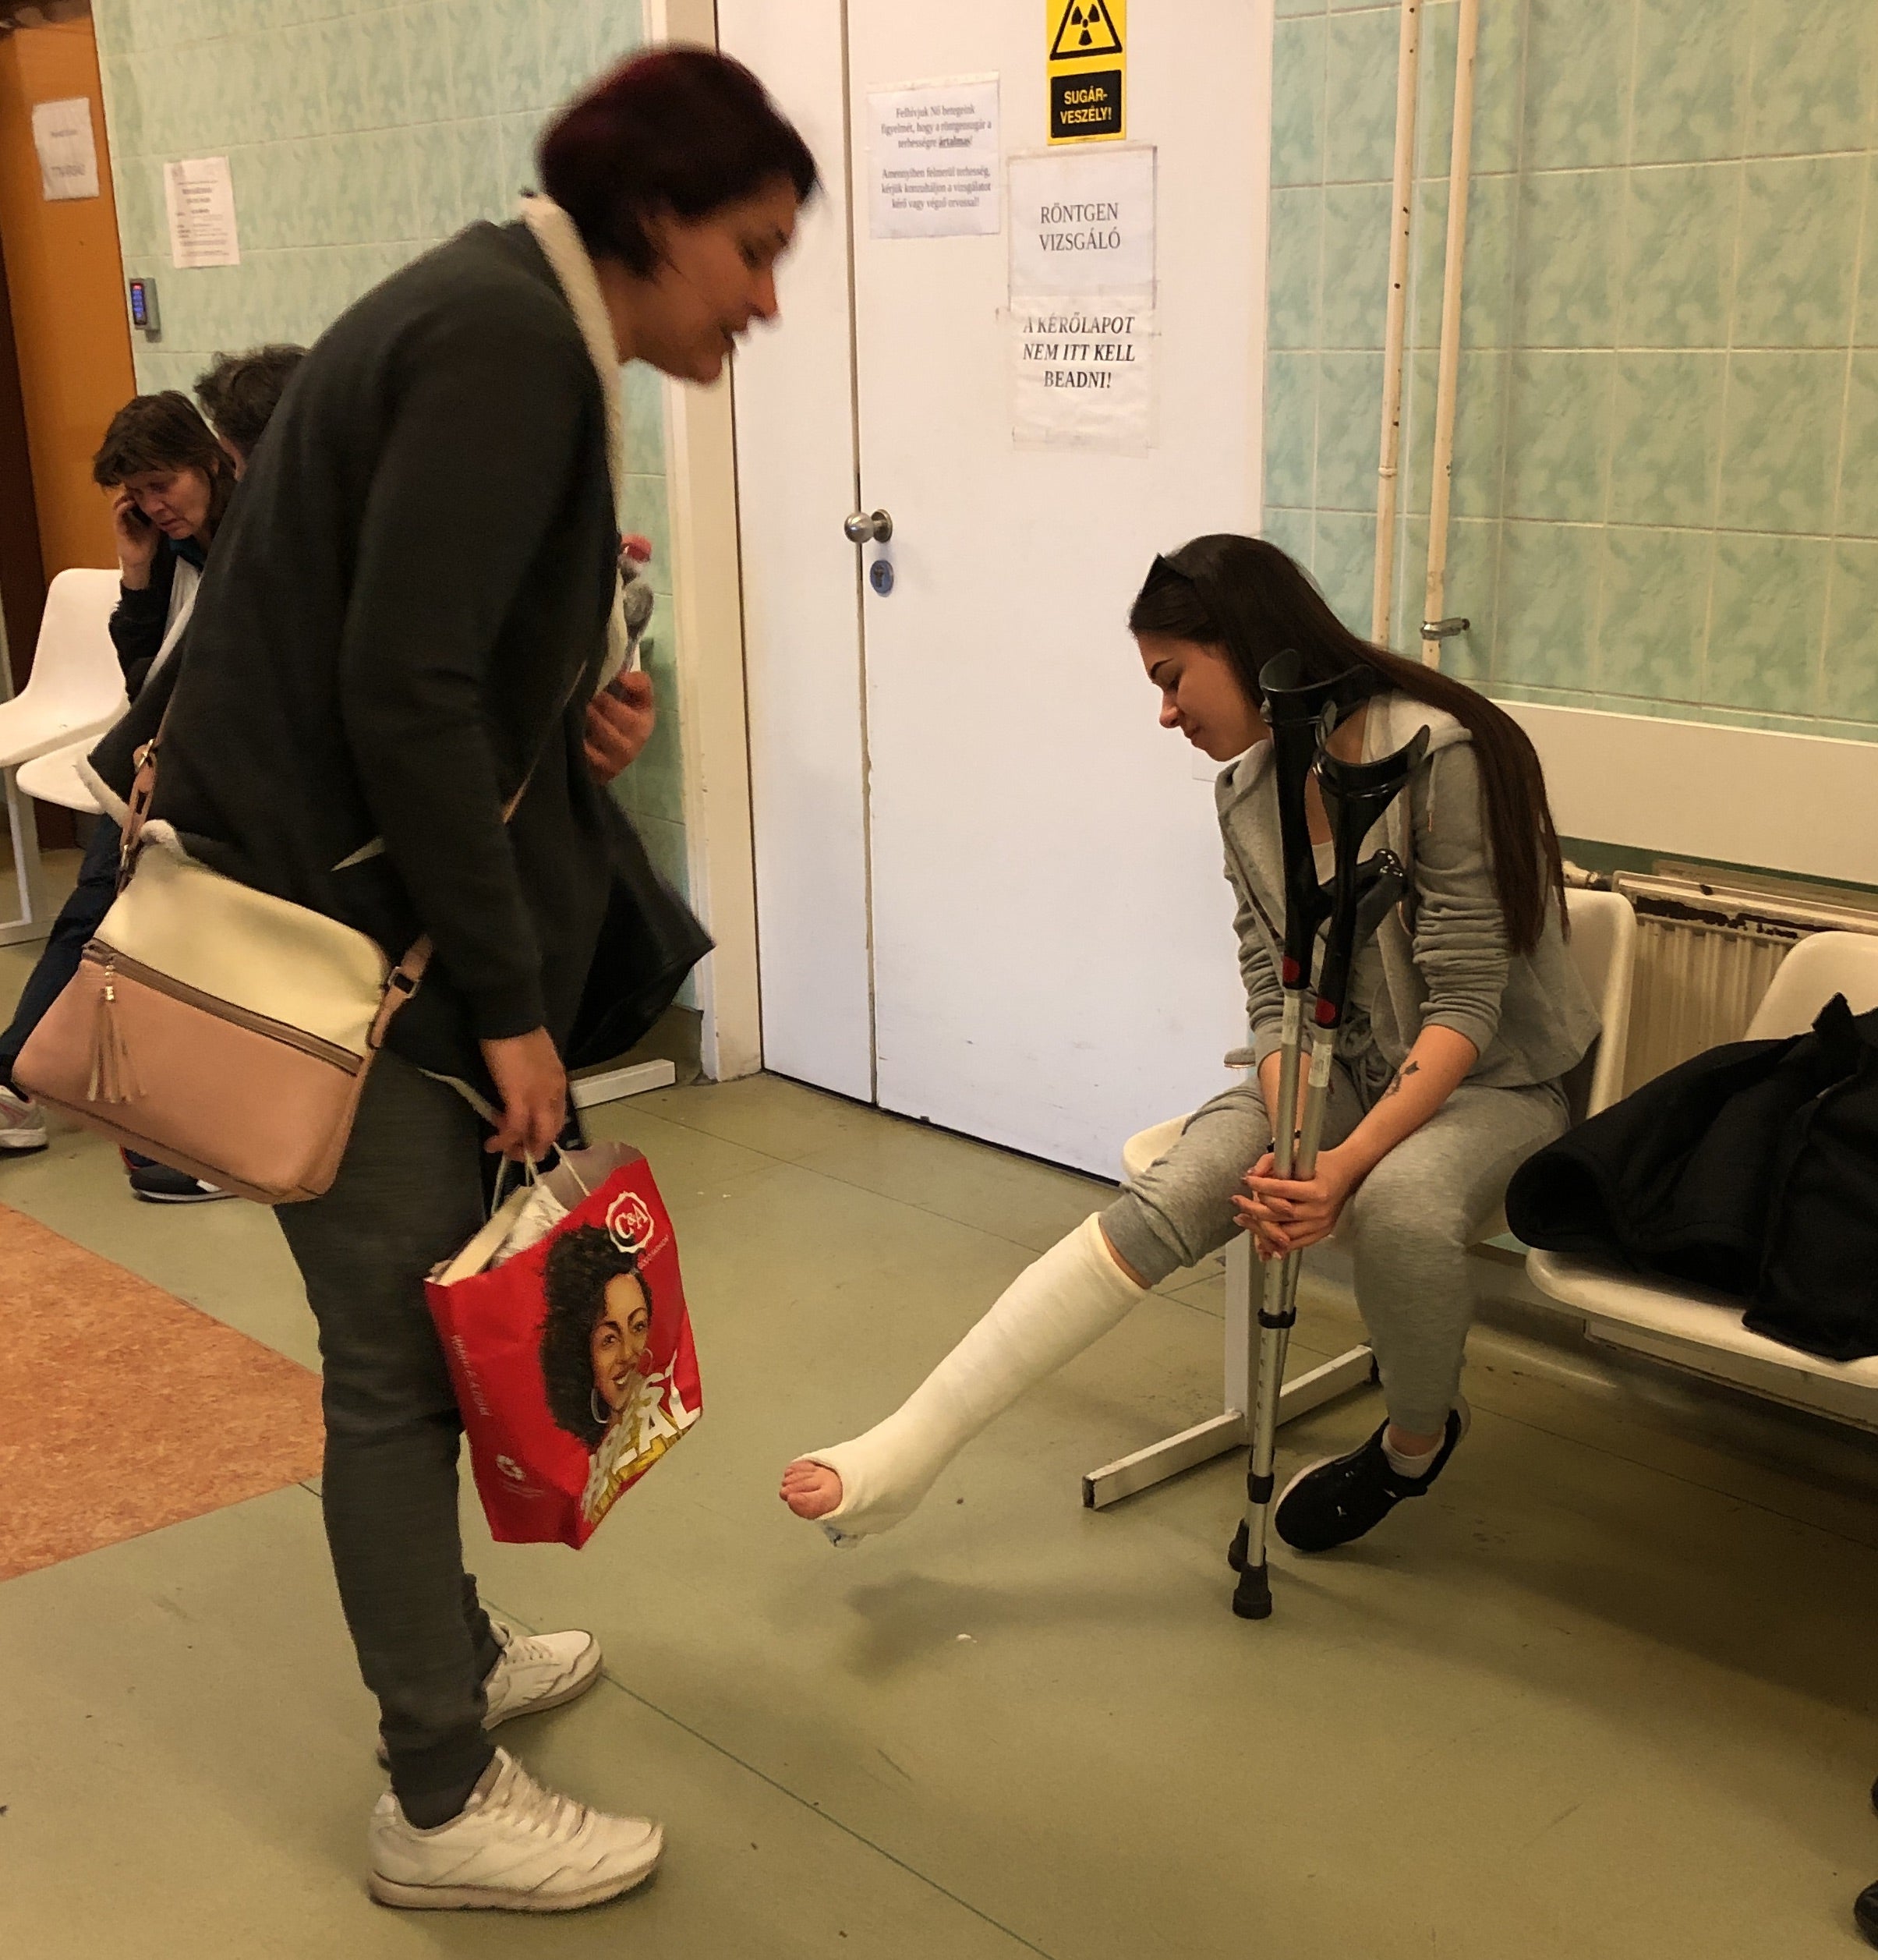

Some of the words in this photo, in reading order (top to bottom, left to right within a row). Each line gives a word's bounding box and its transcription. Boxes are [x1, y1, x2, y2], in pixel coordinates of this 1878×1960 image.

[1064, 85, 1108, 104] SUGÁR-
[1060, 105, 1112, 124] VESZÉLY!
[1040, 202, 1119, 224] RÖNTGEN
[1039, 226, 1120, 251] VIZSGÁLÓ
[1038, 312, 1135, 334] KÉRŐLAPOT
[1023, 343, 1058, 361] NEM
[1063, 343, 1090, 361] ITT
[1093, 343, 1135, 362] KELL
[1043, 370, 1112, 388] BEADNI!
[614, 1203, 649, 1239] C&A
